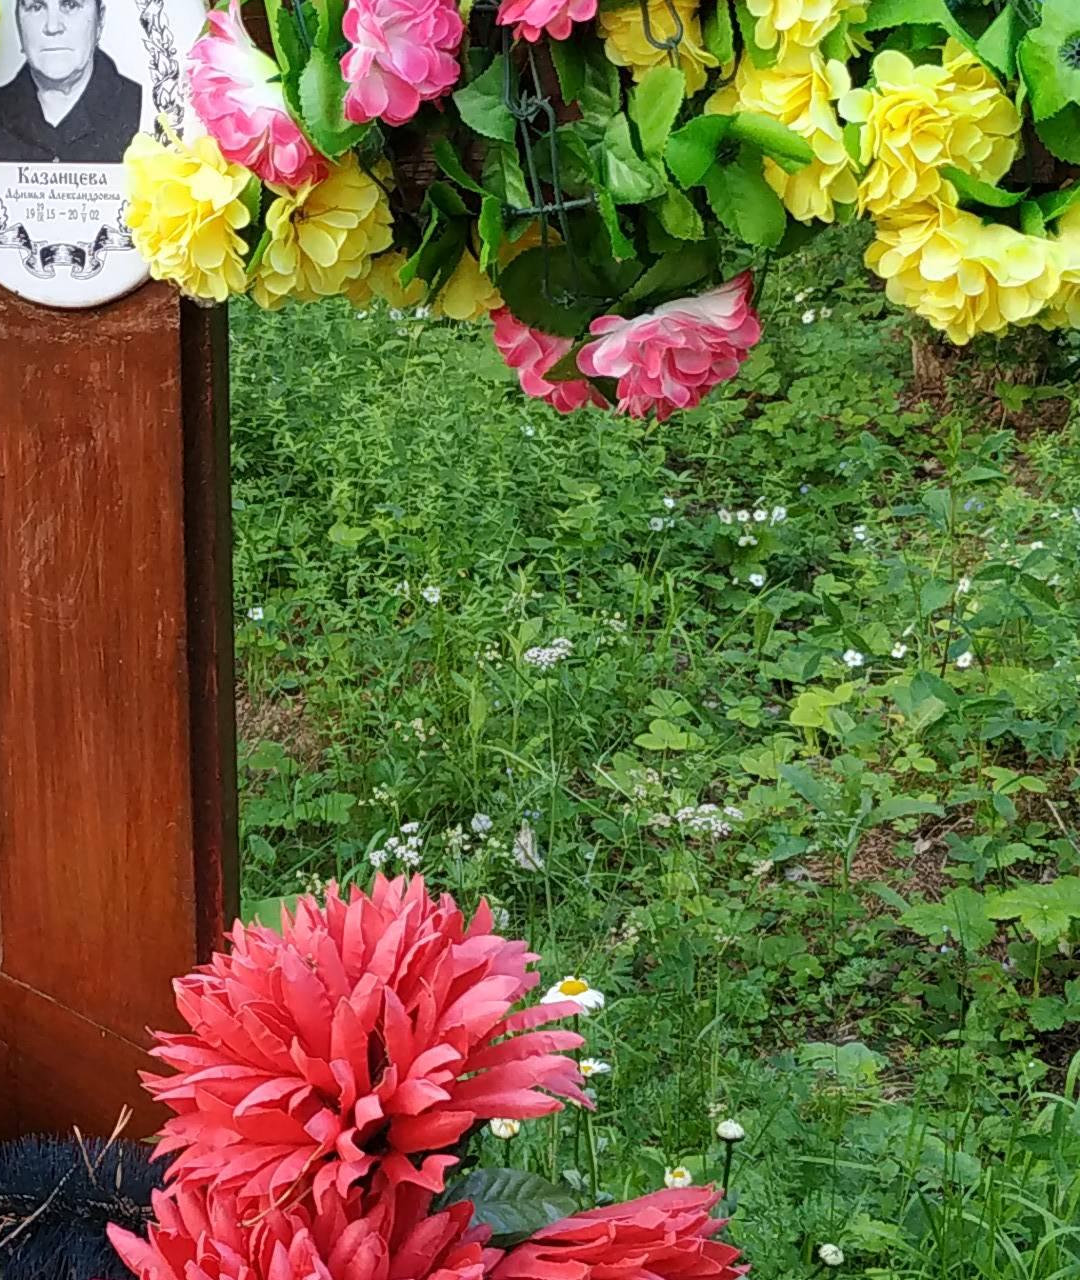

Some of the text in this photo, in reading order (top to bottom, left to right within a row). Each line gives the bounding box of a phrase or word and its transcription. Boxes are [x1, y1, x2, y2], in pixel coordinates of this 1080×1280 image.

[17, 166, 108, 189] Казанцева
[48, 189, 121, 202] Александровна
[25, 207, 36, 220] 19
[46, 208, 56, 220] 15
[67, 208, 79, 221] 20
[89, 208, 100, 221] 02
